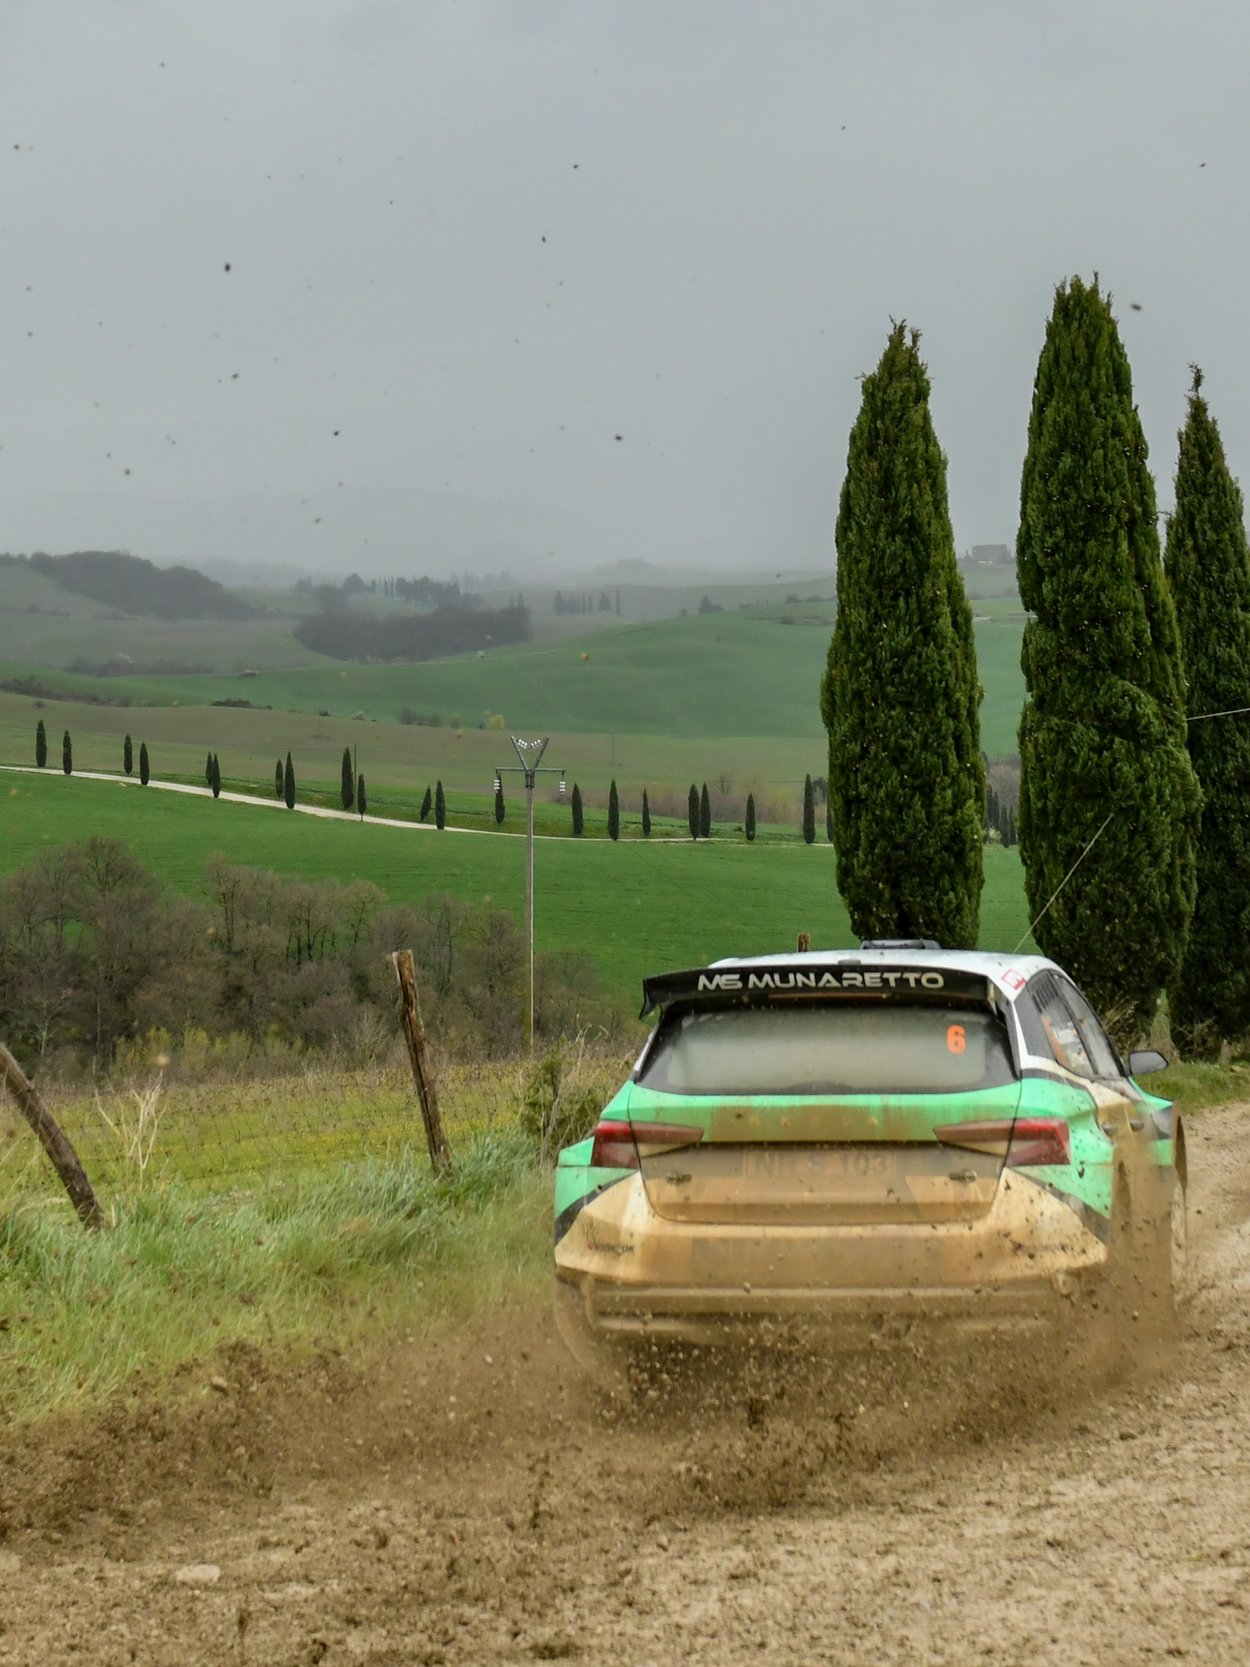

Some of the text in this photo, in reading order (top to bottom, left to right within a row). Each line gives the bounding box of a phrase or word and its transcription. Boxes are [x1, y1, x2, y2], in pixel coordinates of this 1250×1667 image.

[697, 971, 945, 991] MS MUNARETTO
[946, 1025, 966, 1054] 6
